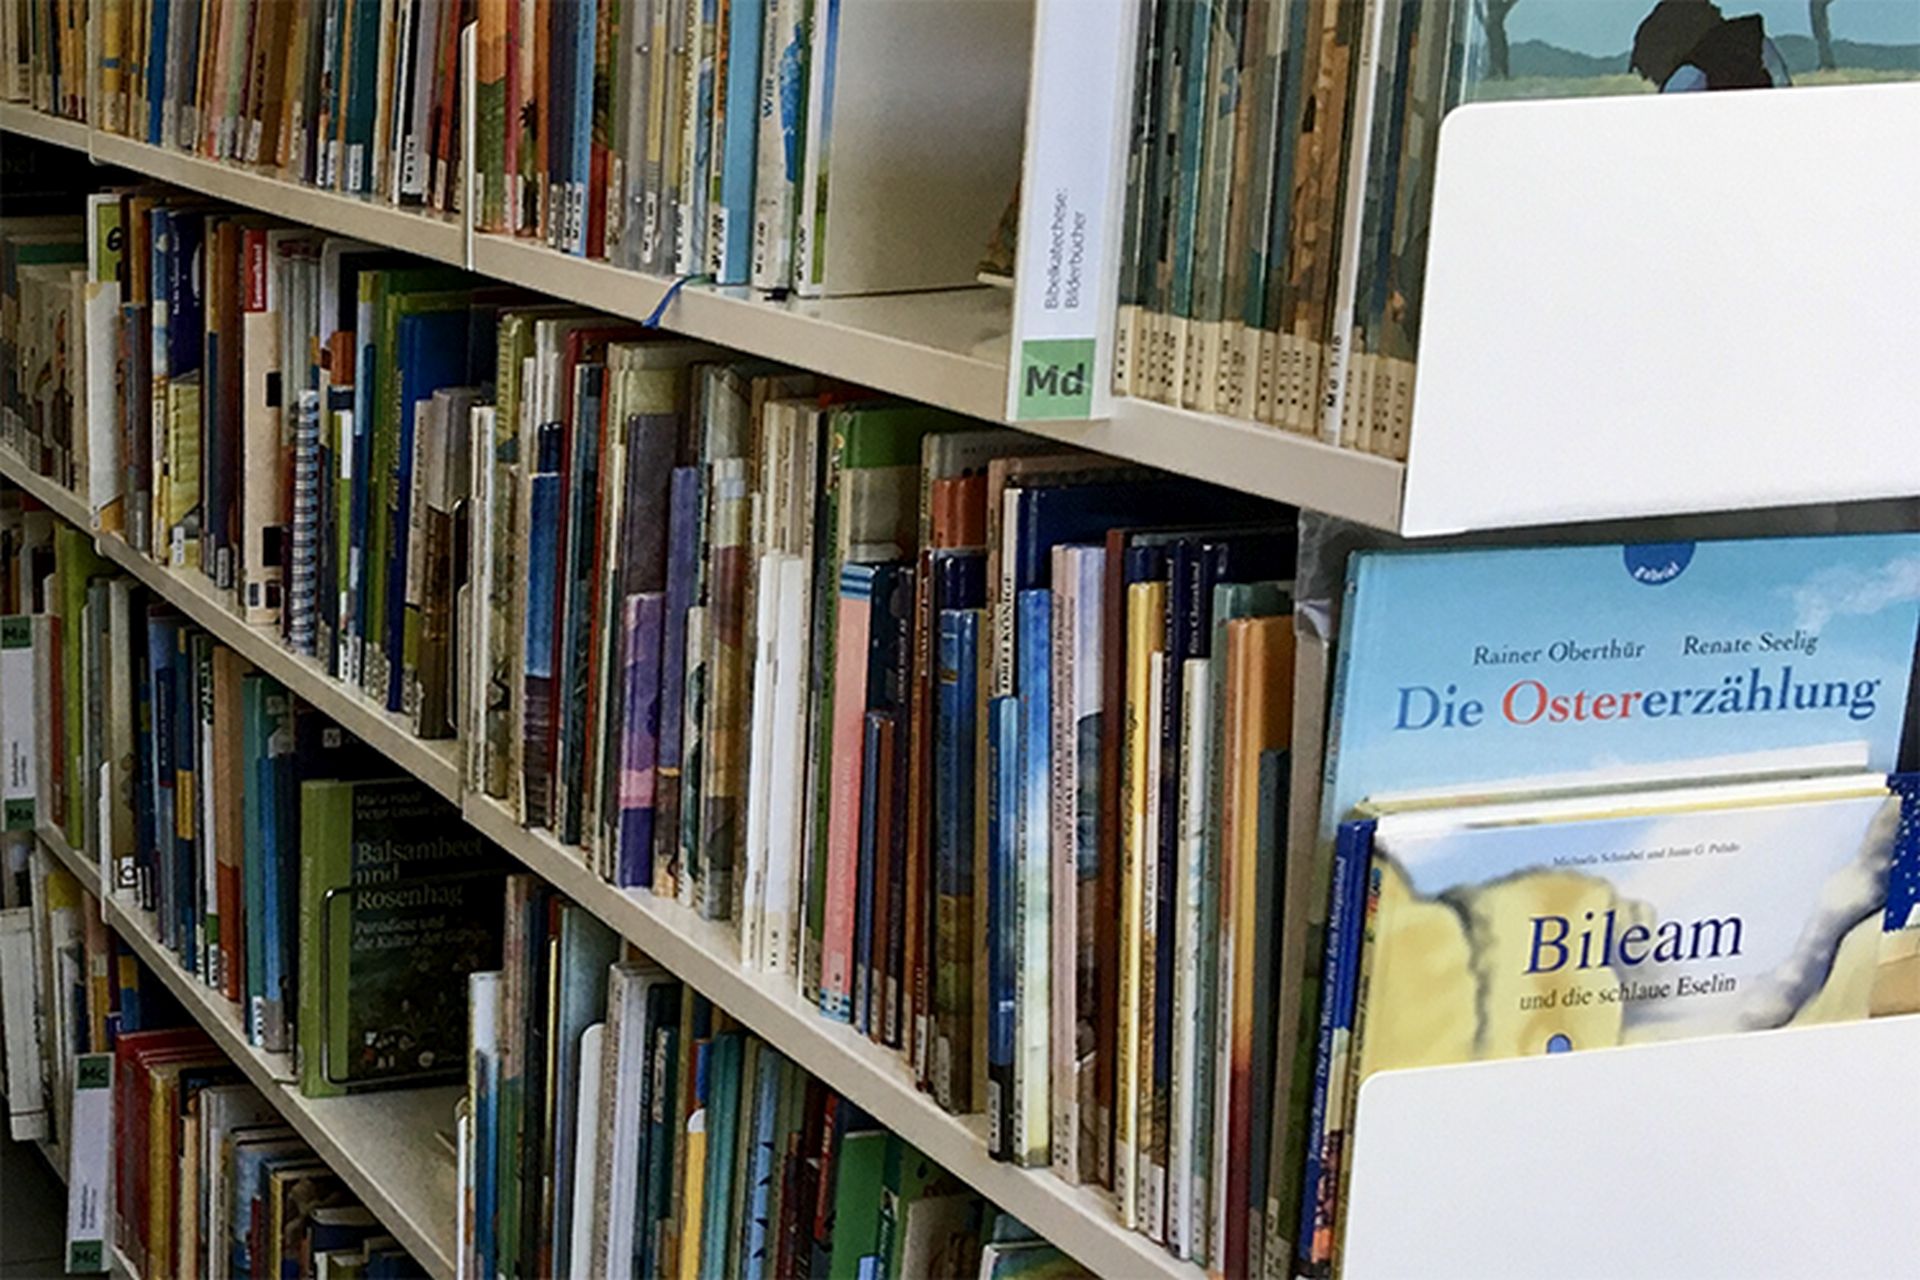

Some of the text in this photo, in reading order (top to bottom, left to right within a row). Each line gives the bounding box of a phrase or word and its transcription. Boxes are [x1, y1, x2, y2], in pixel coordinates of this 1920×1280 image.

[1045, 187, 1067, 309] Bibelkatechese:
[1065, 211, 1086, 309] Bilderbücher
[1025, 362, 1085, 397] Md
[1473, 630, 1819, 666] Rainer Oberthür Renate Seelig
[1394, 665, 1882, 731] Die Ostererzählung
[1646, 848, 1666, 860] und
[1521, 909, 1743, 975] Bileam
[1519, 973, 1738, 1010] und die schlaue Eselin
